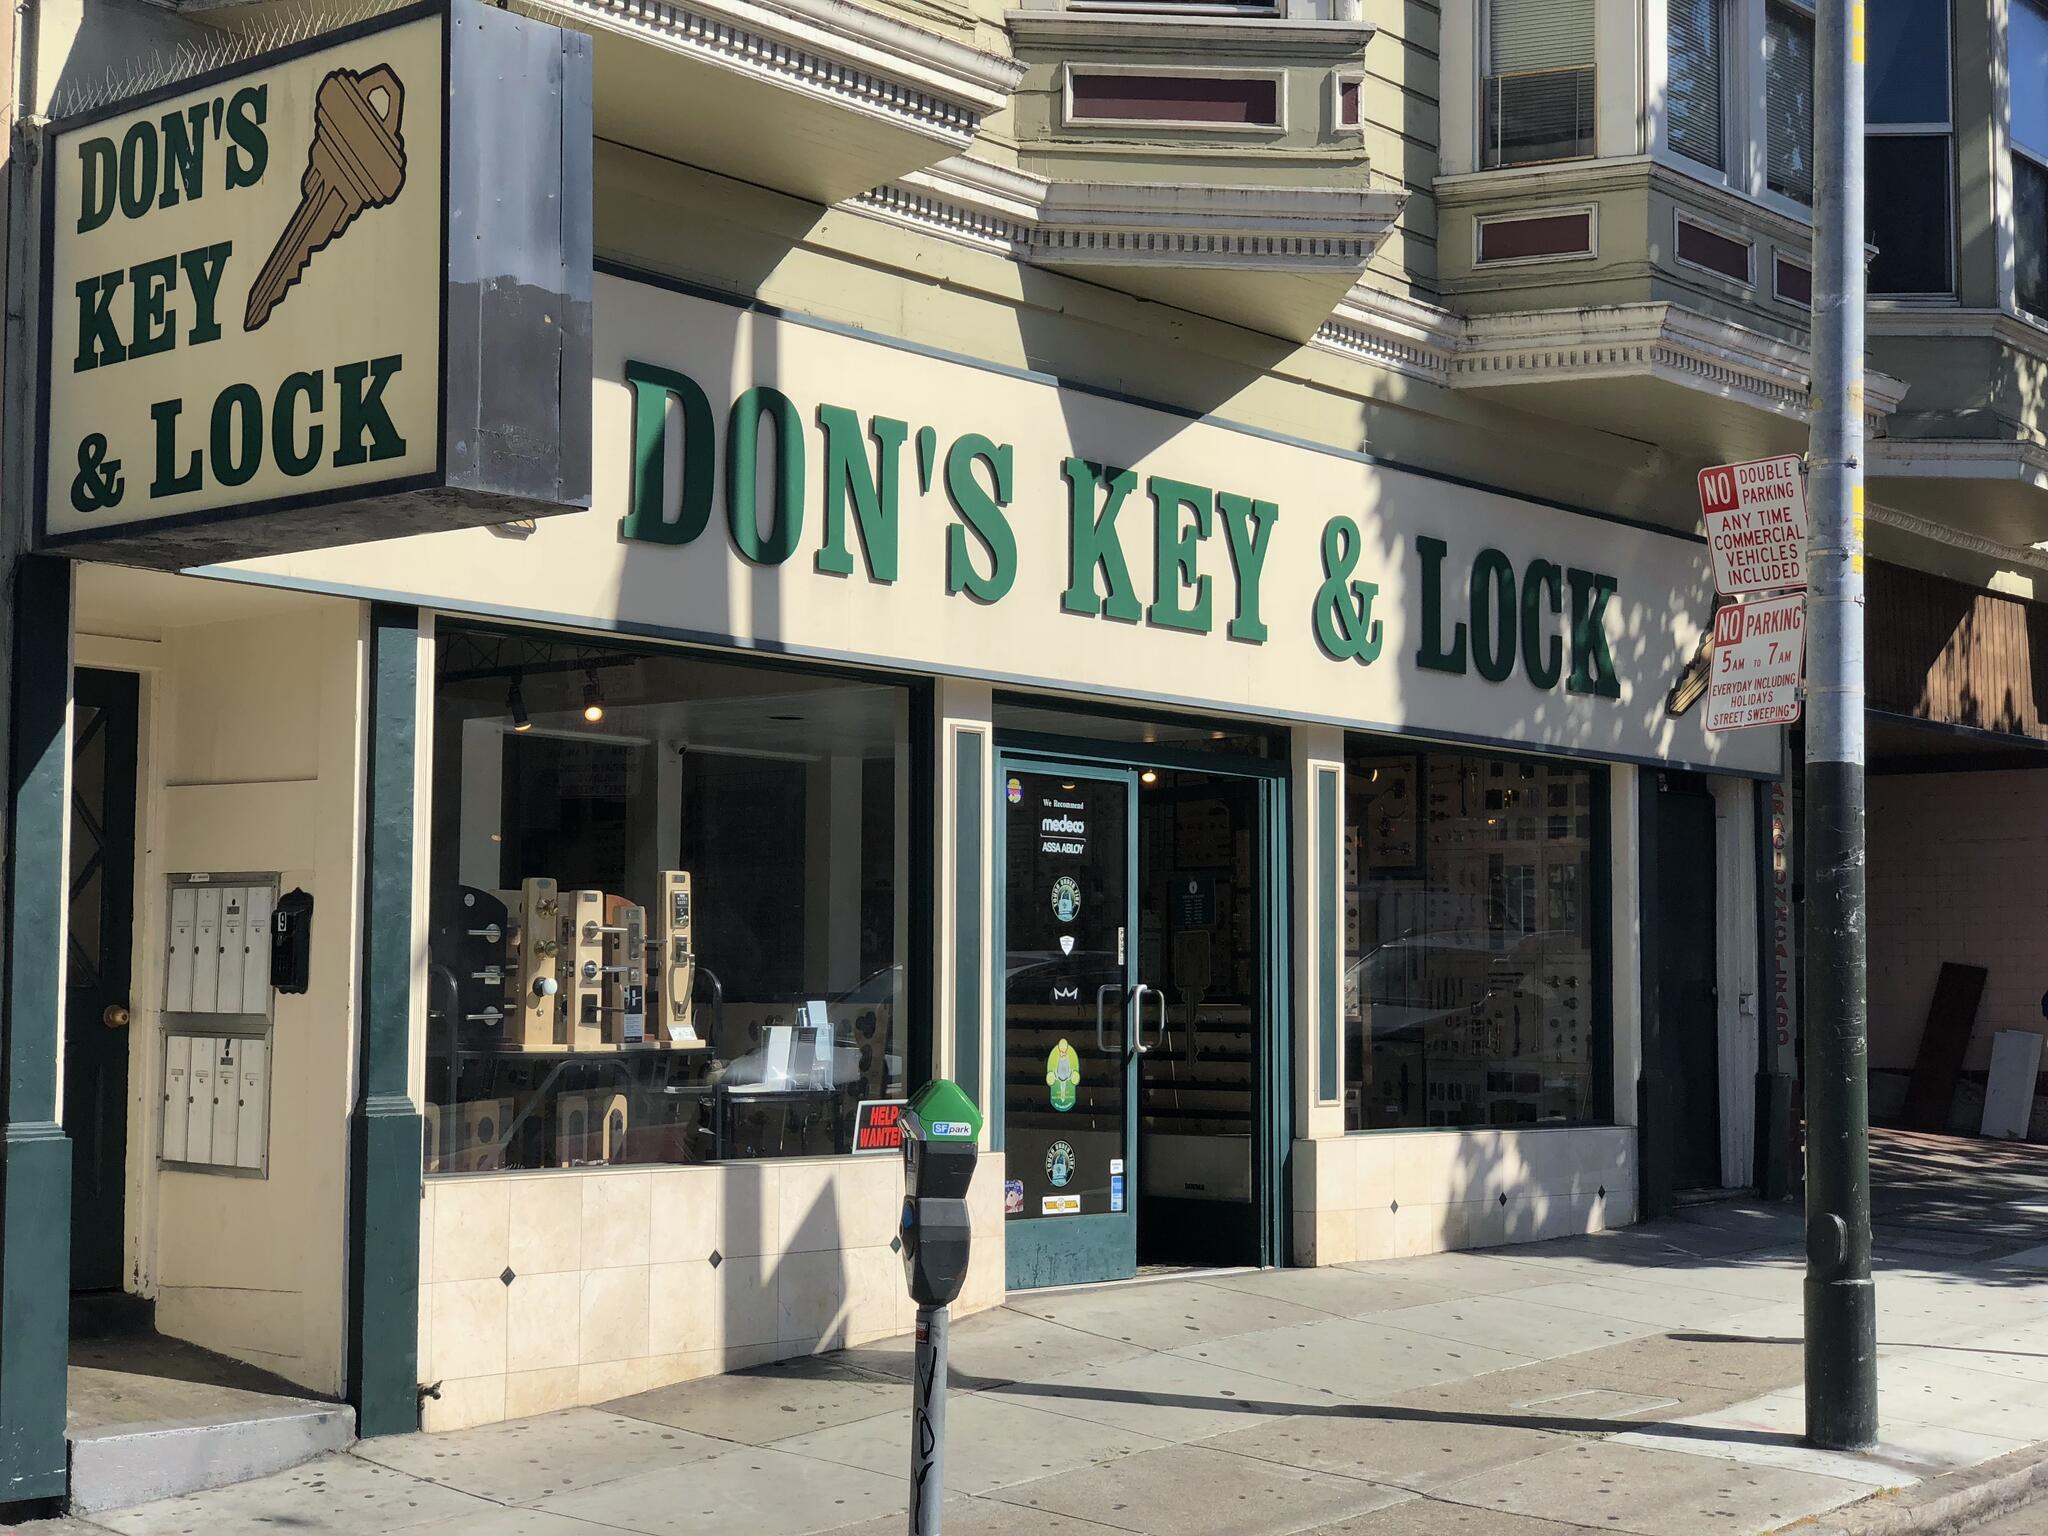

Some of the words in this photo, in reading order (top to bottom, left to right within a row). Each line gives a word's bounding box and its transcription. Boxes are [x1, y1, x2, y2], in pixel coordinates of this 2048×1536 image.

[76, 83, 269, 235] DON'S
[73, 241, 232, 374] KEY
[70, 432, 126, 513] &
[149, 354, 407, 499] LOCK
[1739, 462, 1792, 485] DOUBLE
[1704, 472, 1731, 506] NO
[1742, 482, 1794, 504] PARKING
[620, 359, 1018, 603] DON'S
[1062, 456, 1279, 644] KEY
[1315, 515, 1383, 664] &
[1416, 535, 1621, 698] LOCK
[1721, 512, 1751, 532] ANY
[1757, 507, 1793, 526] TIME
[1714, 524, 1804, 550] COMMERCIAL
[1725, 543, 1798, 568] VEHICLES
[1727, 562, 1800, 586] INCLUDED
[1717, 609, 1741, 643] NO
[1746, 606, 1801, 638] PARKING
[1712, 678, 1752, 697] EVERYDAY
[1754, 672, 1796, 690] INCLUDING
[1730, 691, 1774, 708] HOLIDAYS
[1713, 709, 1744, 726] STREET
[1747, 703, 1790, 722] SWEEPING
[1043, 799, 1052, 808] We
[1053, 799, 1084, 810] Recommend
[1042, 814, 1085, 834] medeco
[1042, 841, 1061, 853] ASSA
[1061, 843, 1085, 855] ABLOY
[279, 912, 286, 930] 9
[870, 1105, 899, 1126] HELP
